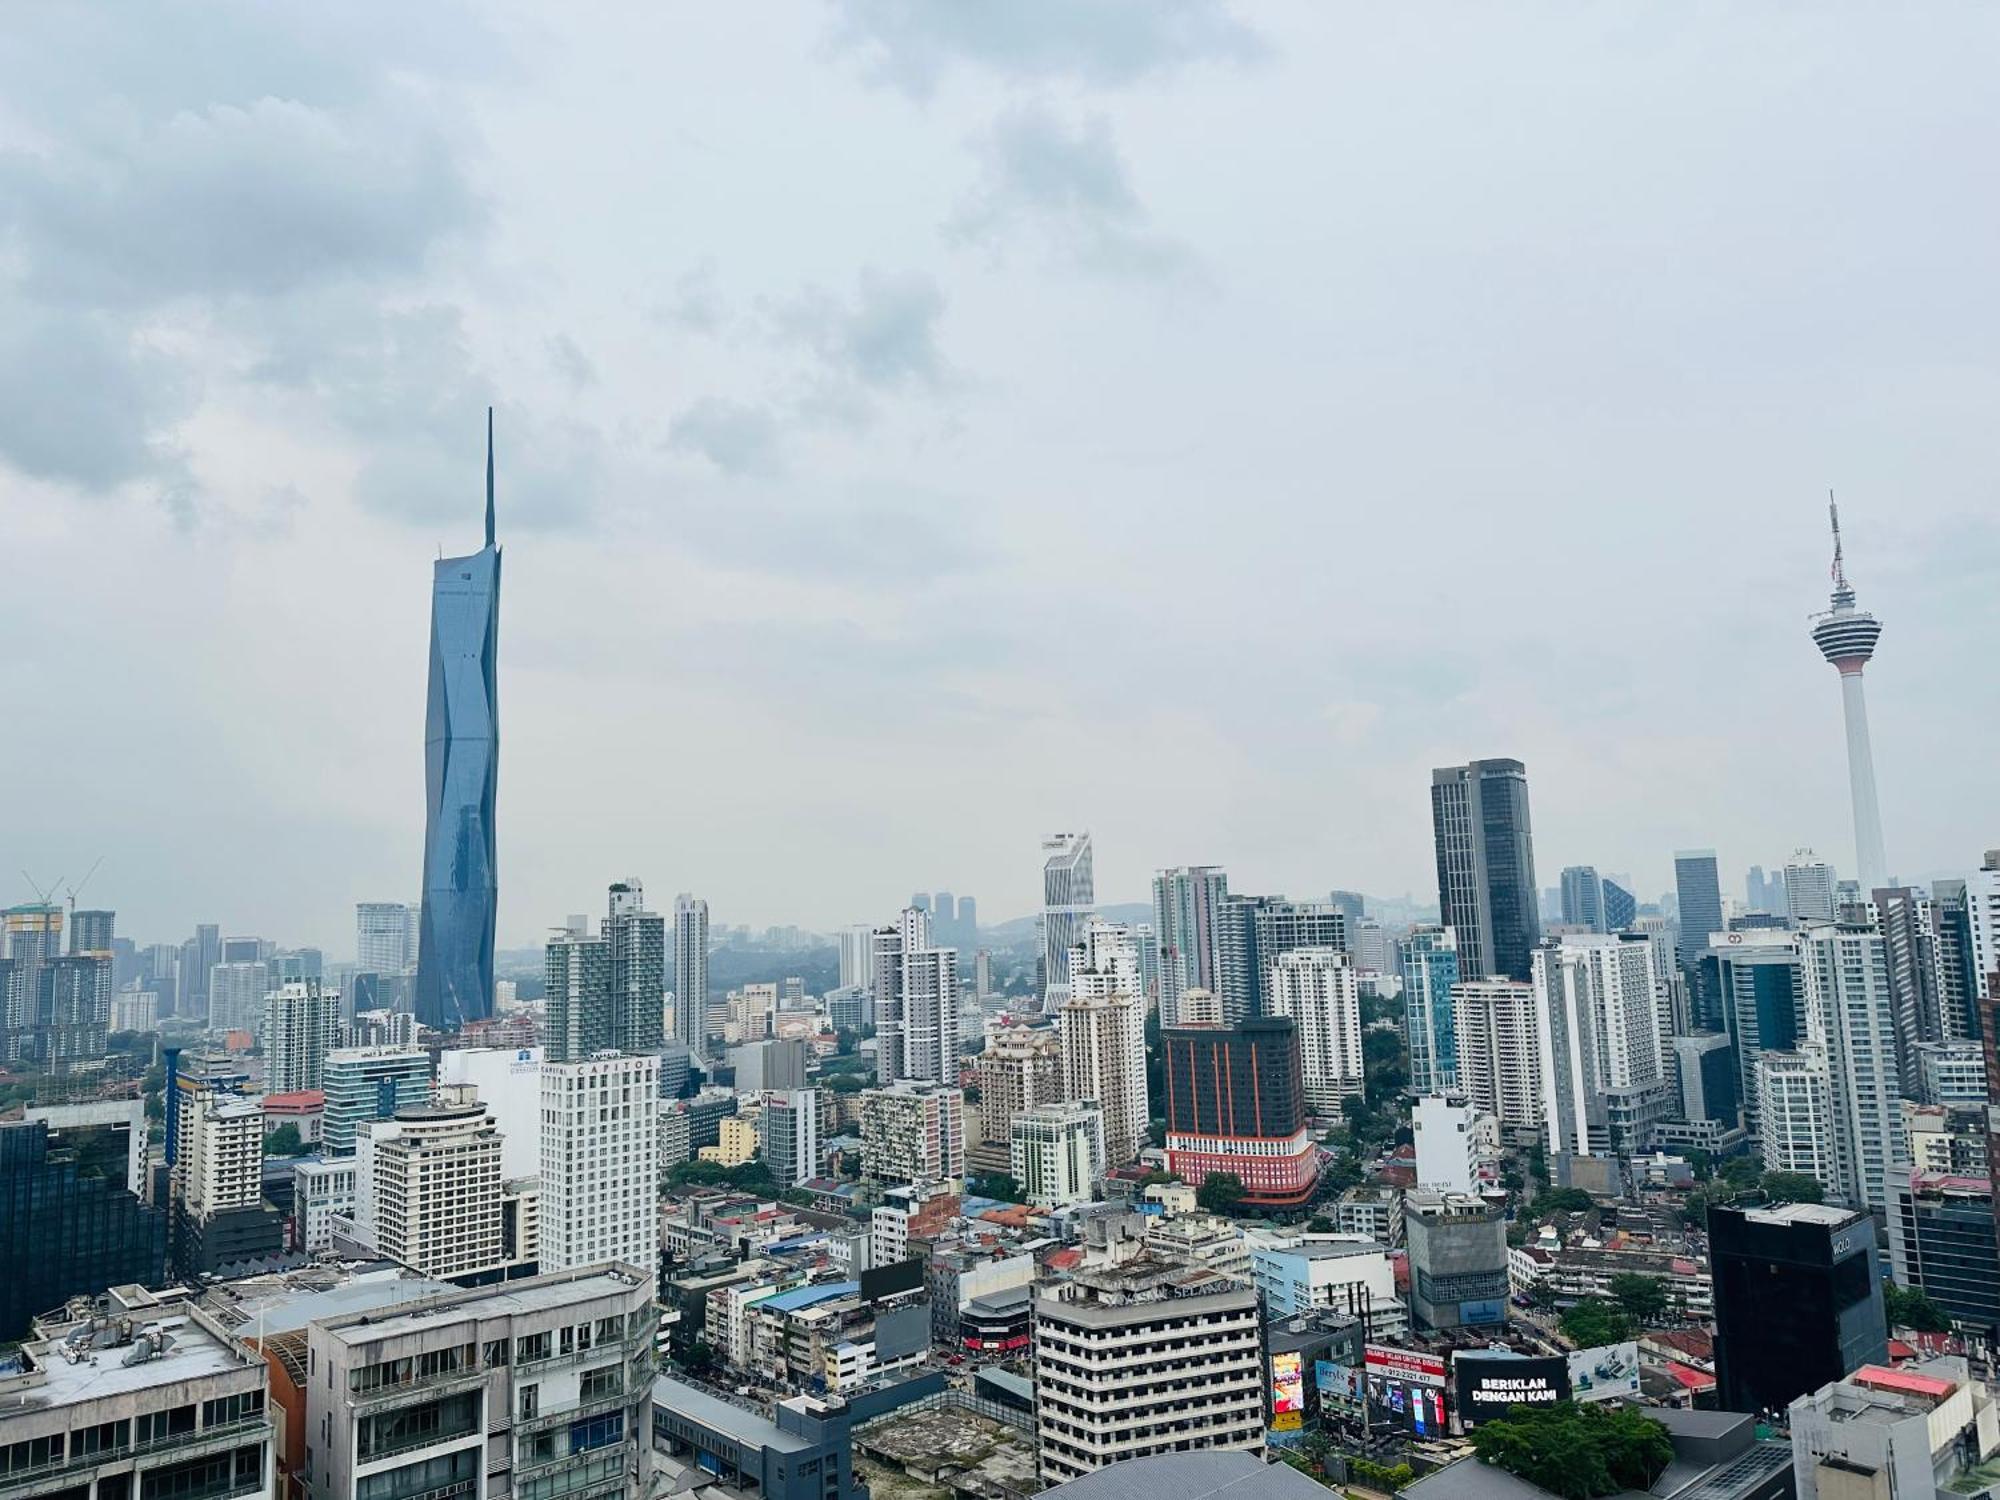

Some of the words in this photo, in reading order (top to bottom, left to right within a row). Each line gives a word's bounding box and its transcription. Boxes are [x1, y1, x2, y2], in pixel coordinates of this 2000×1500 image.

[577, 1059, 654, 1076] CAPITOL
[1832, 1237, 1850, 1256] WOLO
[1481, 1378, 1547, 1390] BERIKLAN
[1472, 1390, 1526, 1402] DENGAN
[1527, 1389, 1557, 1402] KAMI
